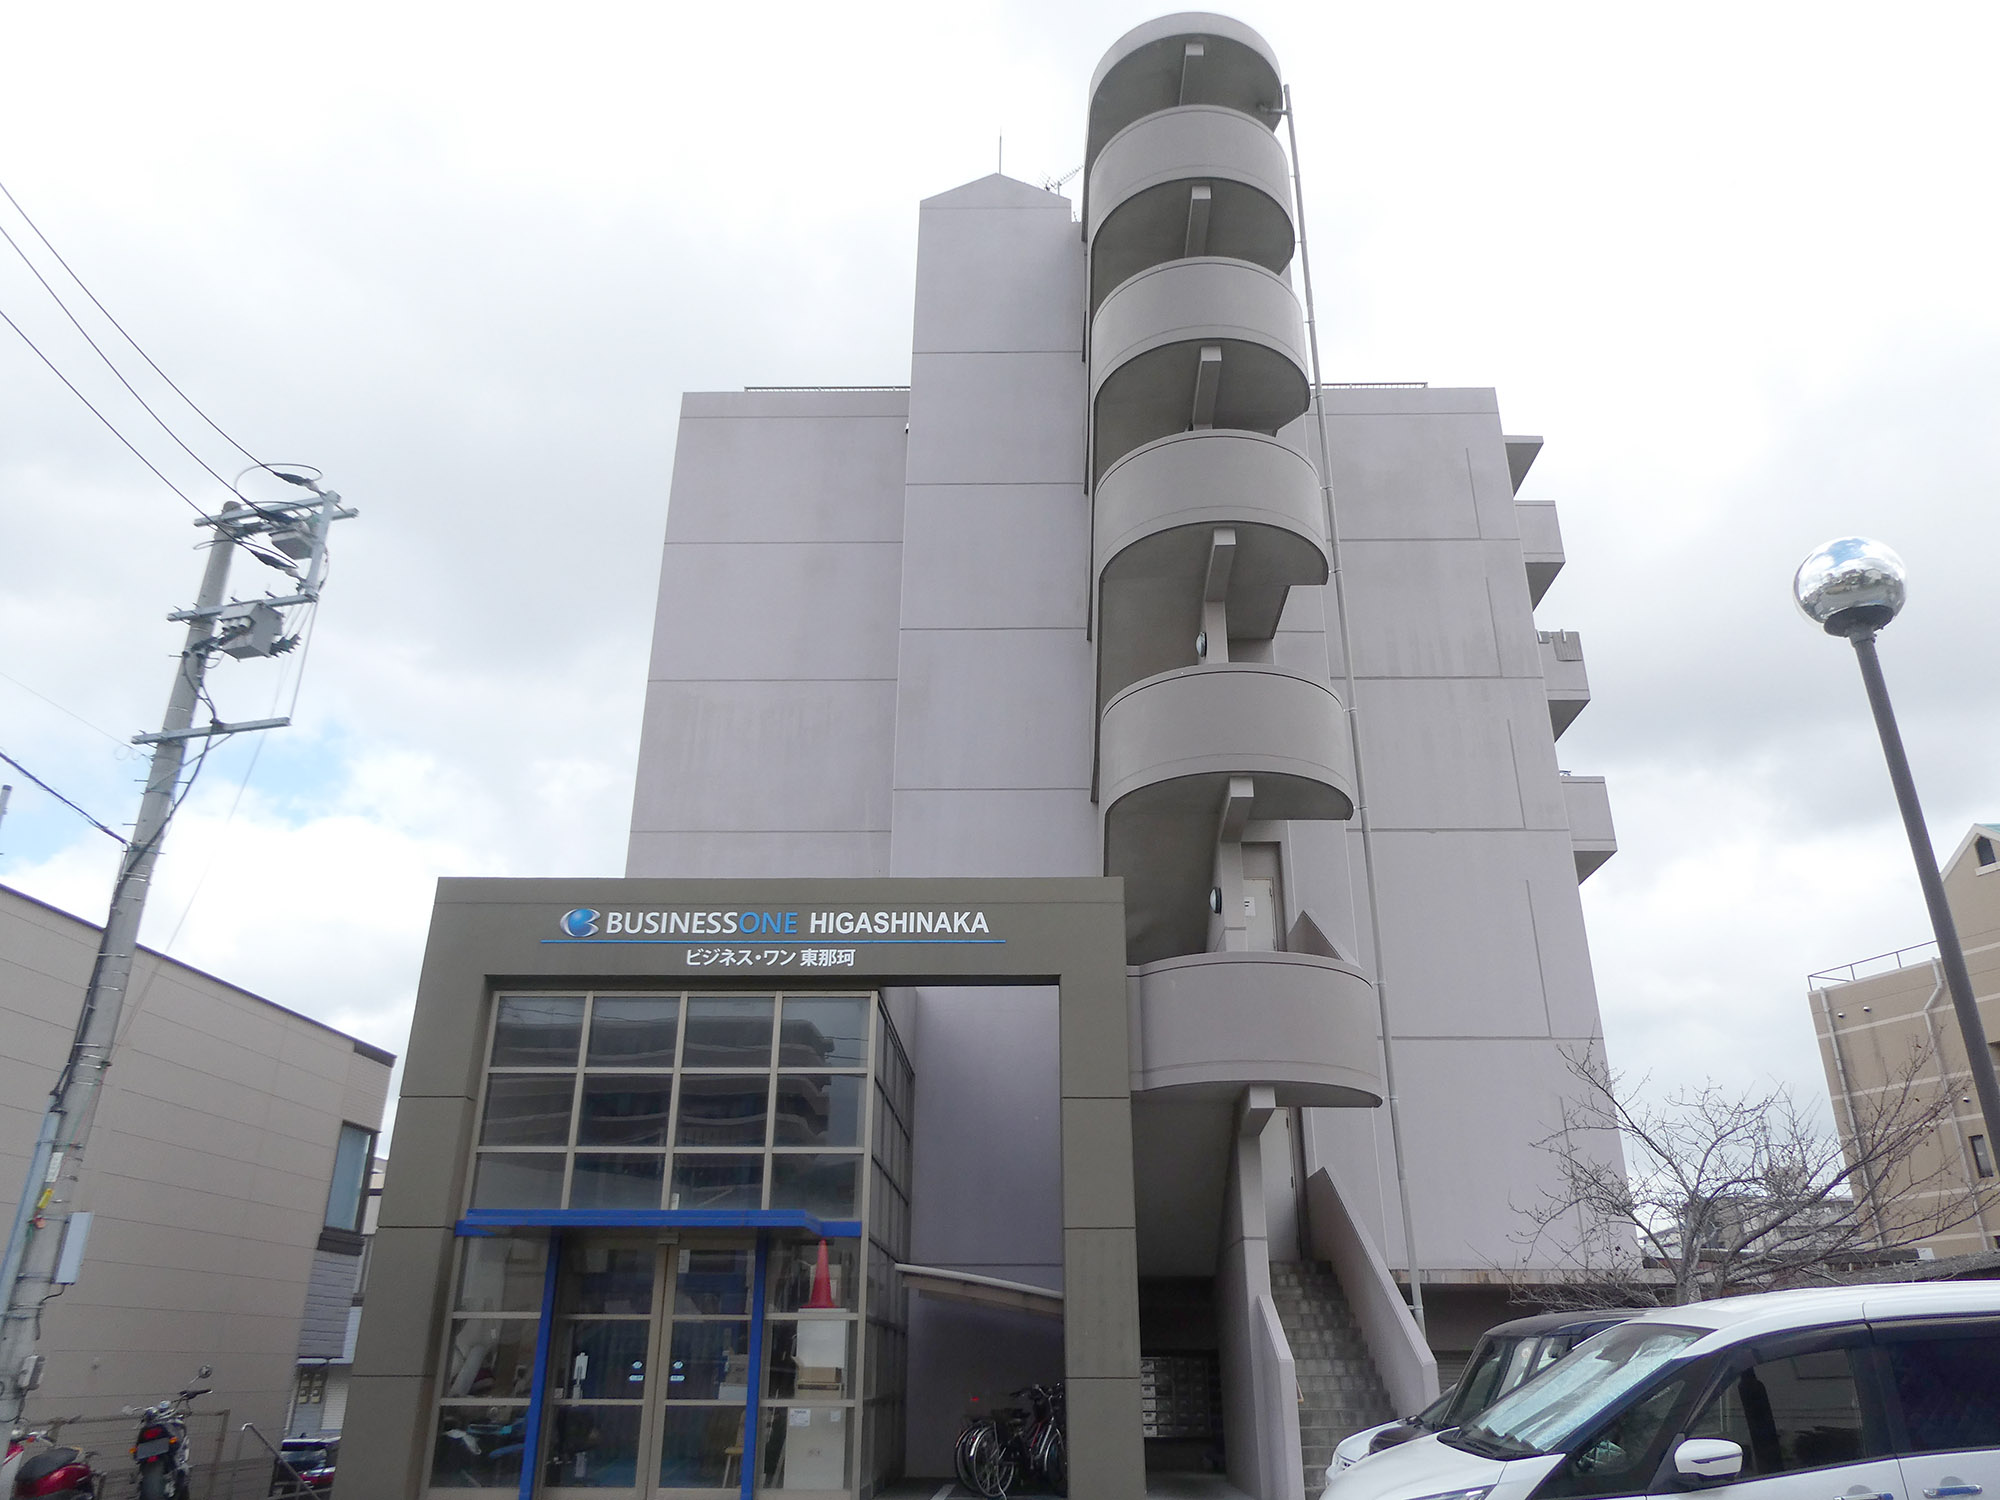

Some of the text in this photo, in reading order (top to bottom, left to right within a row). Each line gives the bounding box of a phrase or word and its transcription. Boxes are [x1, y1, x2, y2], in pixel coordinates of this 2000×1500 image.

[606, 911, 990, 935] BUSINESSONE HIGASHINAKA
[686, 948, 856, 968] ビジネス・ワン 東那珂
